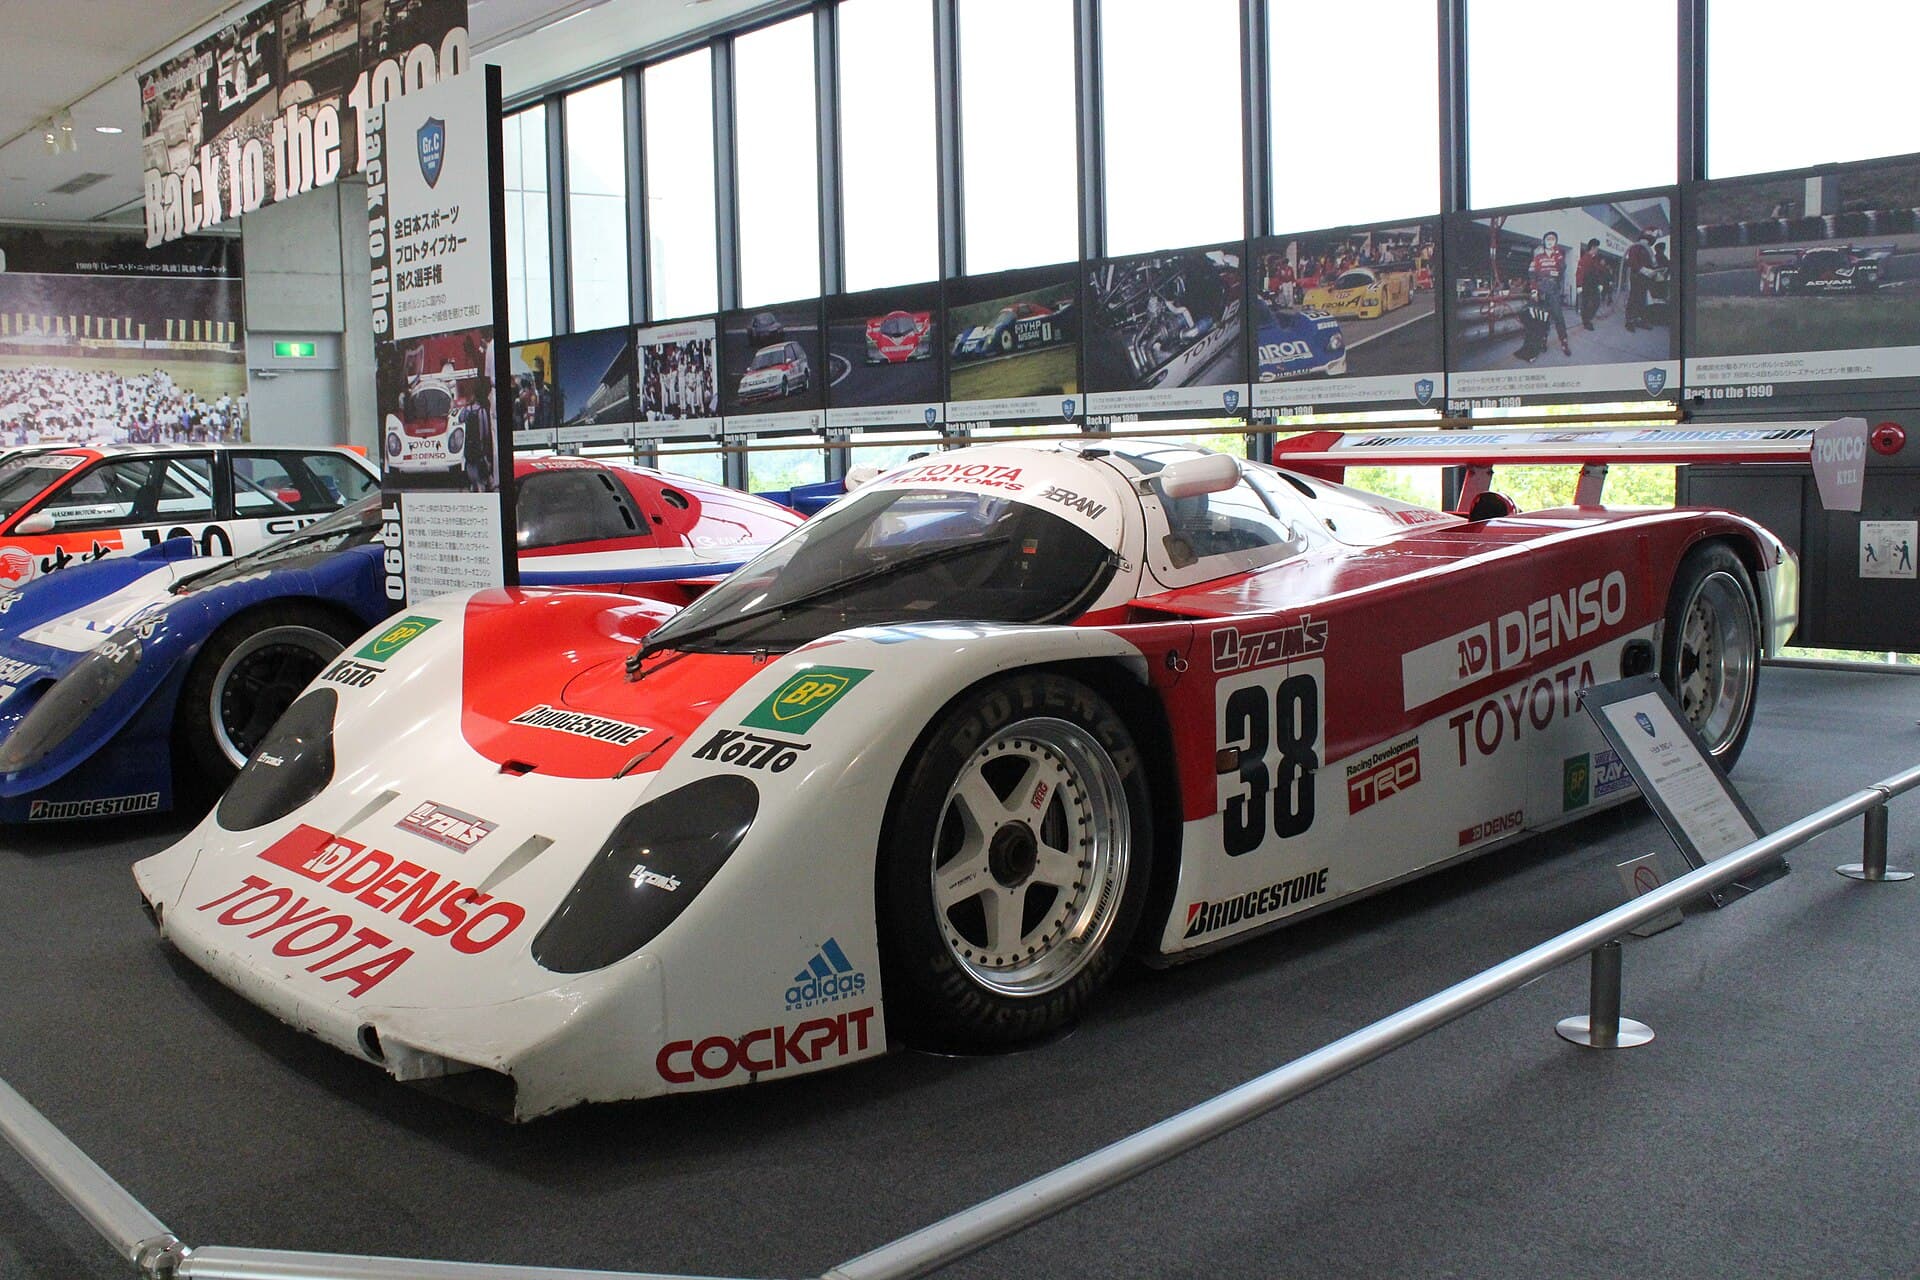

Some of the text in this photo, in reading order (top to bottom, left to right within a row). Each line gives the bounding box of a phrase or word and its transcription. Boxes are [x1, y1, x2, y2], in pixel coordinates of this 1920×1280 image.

[145, 143, 223, 249] Back
[227, 136, 264, 219] to
[272, 102, 342, 203] the
[394, 205, 460, 240] 全日本スポーツ
[395, 234, 467, 265] プロトタイプカー
[396, 263, 443, 292] 耐久選手権
[1805, 279, 1852, 287] ADVAN
[365, 108, 405, 601] Back to the 1990
[1684, 384, 1773, 400] Back to the 1990
[1352, 435, 1507, 447] BRIDGESTONE
[1816, 436, 1864, 463] TOKICO
[891, 476, 1025, 491] TEAM TOM'S
[913, 463, 1024, 481] TOYOTA
[382, 626, 417, 643] BP
[1498, 570, 1627, 671] DENSO
[781, 682, 837, 706] BP
[511, 704, 649, 745] BRIDGESTONE
[1449, 659, 1596, 767] TOYOTA
[1223, 673, 1318, 857] 38
[1346, 735, 1419, 777] Racing Development
[1351, 757, 1417, 804] TRD
[31, 792, 159, 819] BRIDGESTONE
[1483, 809, 1524, 837] DENSO
[326, 848, 526, 955] DENSO
[1183, 867, 1329, 939] BRIDGESTONE
[196, 875, 415, 999] TOYOTA
[785, 972, 866, 1005] adidas
[785, 989, 866, 1011] EQUIPMENT
[655, 1006, 875, 1084] COCKPIT
